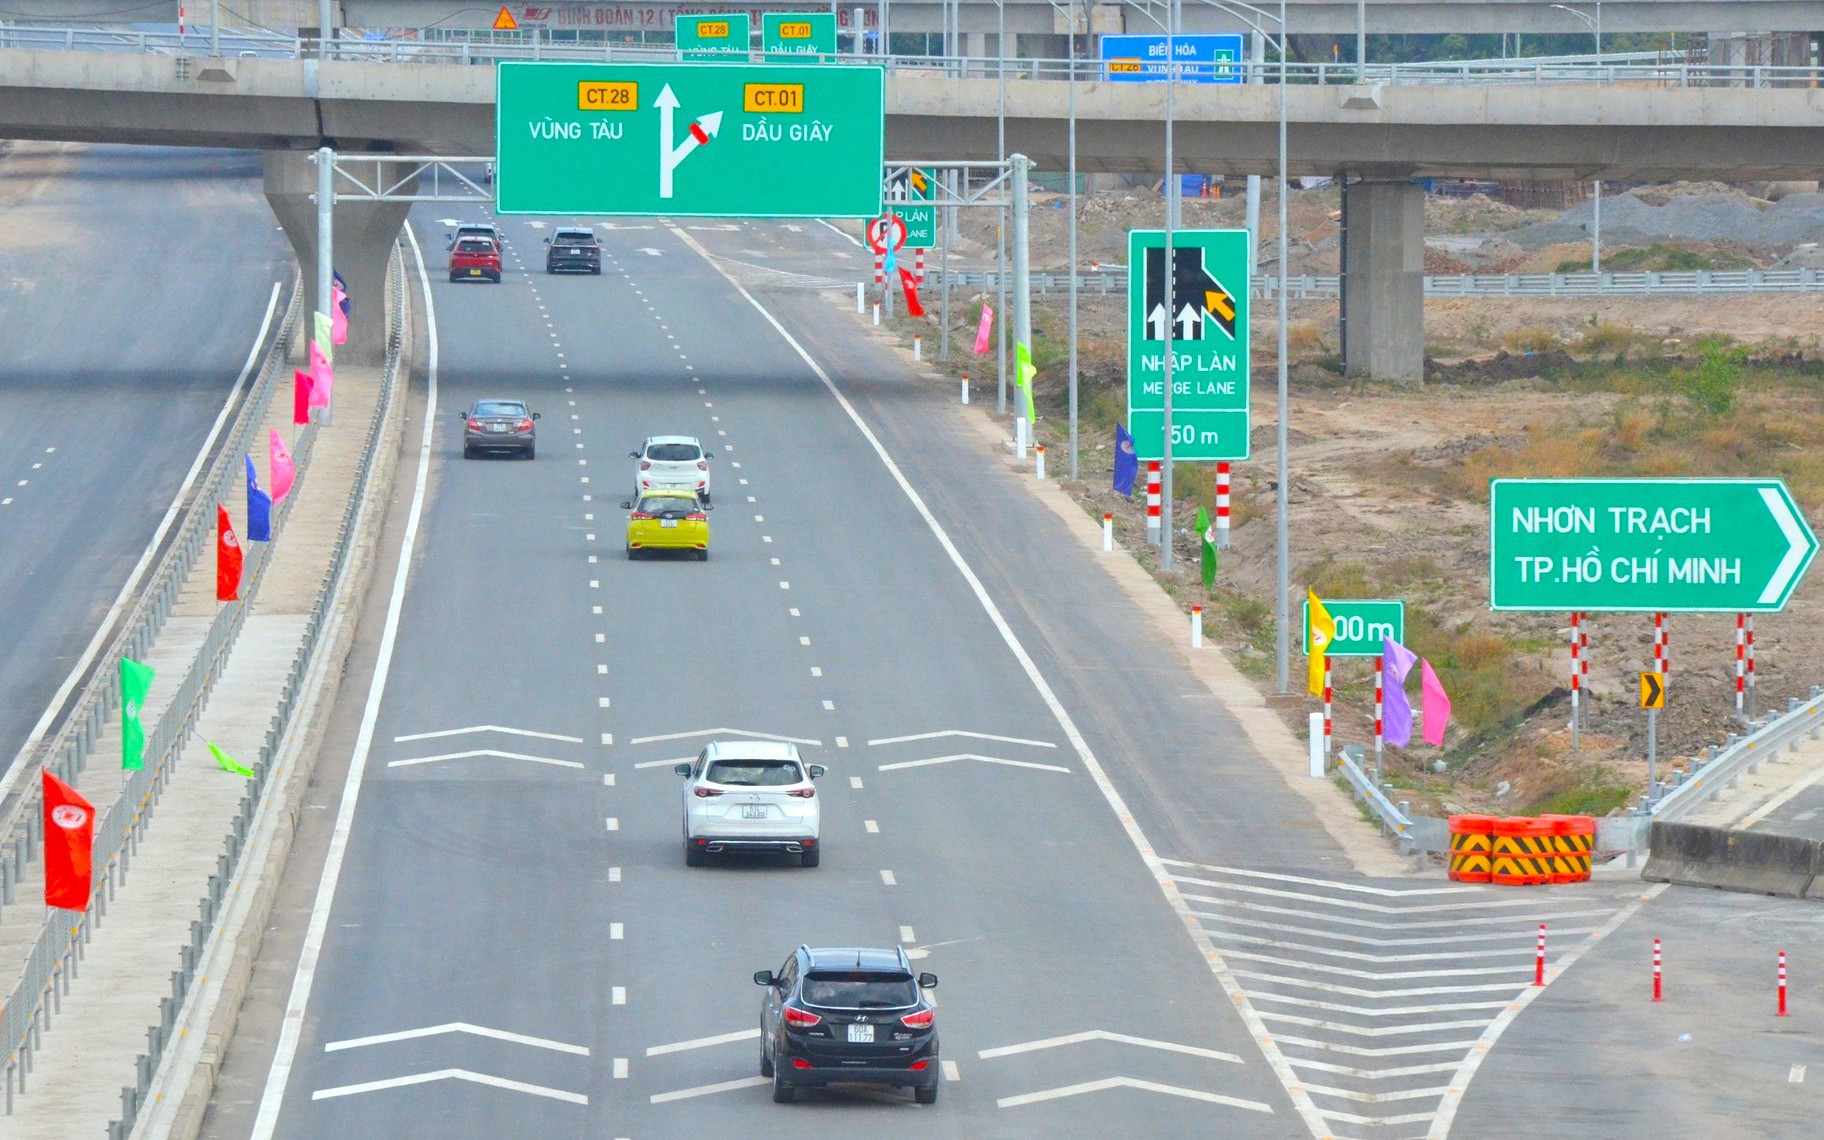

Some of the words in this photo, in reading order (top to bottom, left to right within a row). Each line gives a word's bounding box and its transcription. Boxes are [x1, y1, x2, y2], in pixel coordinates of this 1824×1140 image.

[638, 9, 654, 25] 12
[700, 25, 726, 35] CT.28
[782, 25, 809, 36] CT.01
[1148, 42, 1168, 56] BIÊ
[587, 88, 630, 104] CT.28
[754, 89, 797, 107] CT.01
[528, 116, 582, 140] VŨNG
[589, 118, 623, 140] TÀU
[742, 116, 782, 141] DẦU
[789, 120, 833, 142] GIÂY
[1197, 350, 1236, 372] LÀN
[1143, 382, 1192, 395] MEGE
[1197, 382, 1236, 395] LANE
[1161, 425, 1195, 445] 50
[1200, 431, 1218, 445] m
[1512, 504, 1596, 534] NHƠN
[1608, 507, 1711, 541] TRẠCH
[1610, 548, 1659, 584] CHÍ
[1668, 557, 1741, 584] MINH
